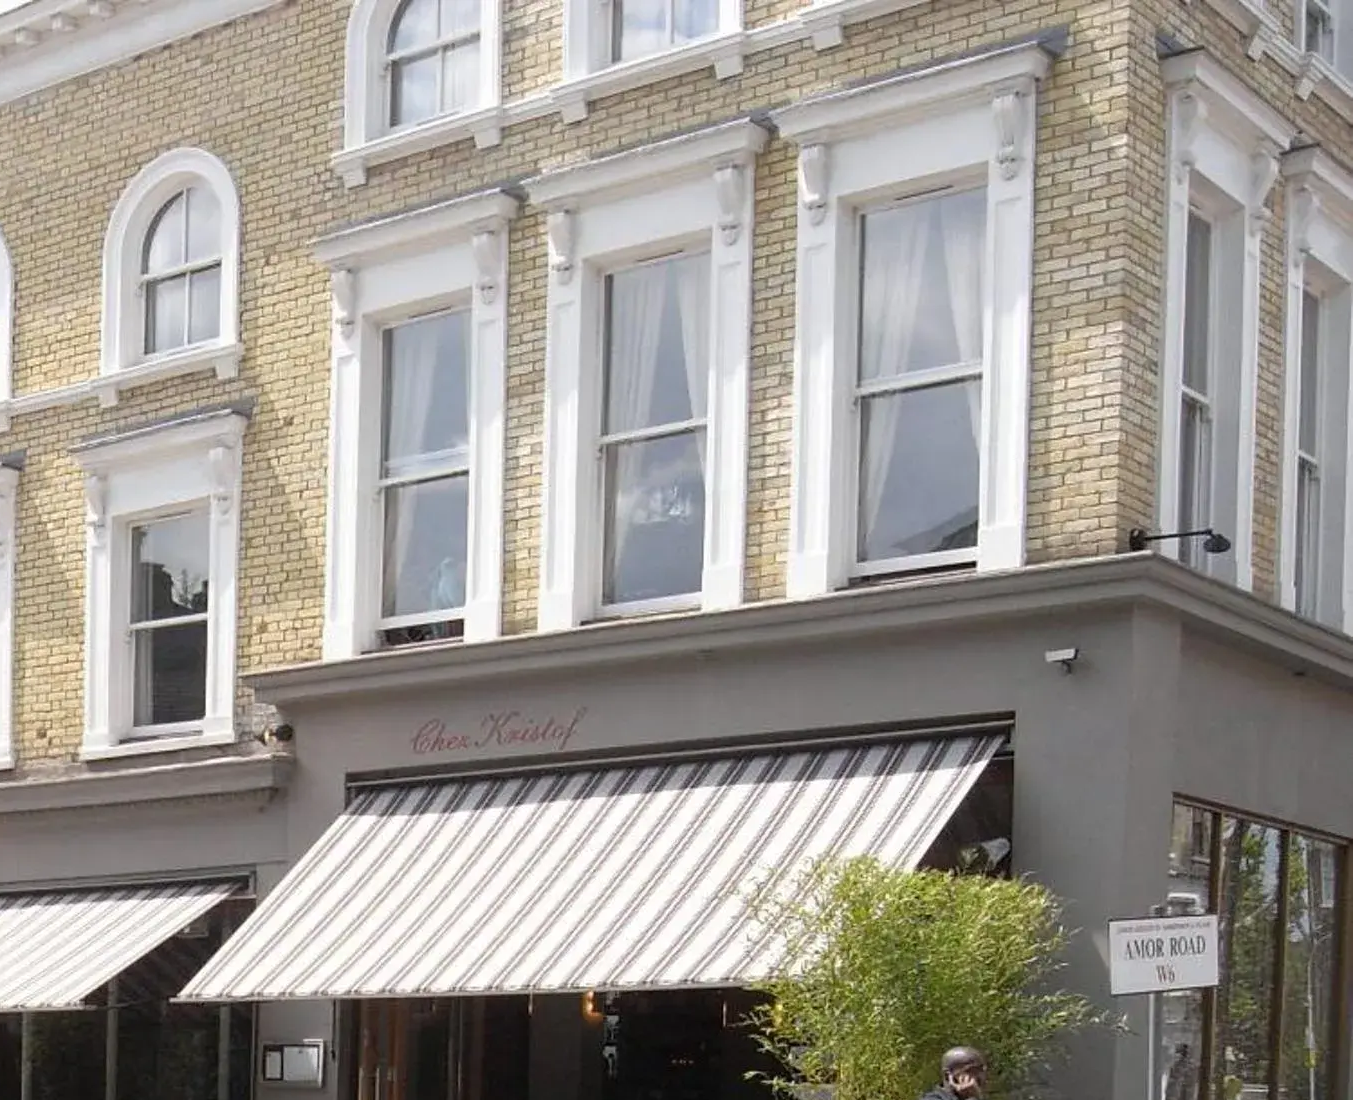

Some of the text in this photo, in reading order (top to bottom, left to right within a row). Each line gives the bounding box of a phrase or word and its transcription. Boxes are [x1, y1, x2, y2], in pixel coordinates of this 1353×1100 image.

[411, 706, 588, 754] Chez Kristof
[1125, 935, 1206, 960] AMOR ROAD
[1155, 964, 1176, 983] W6
